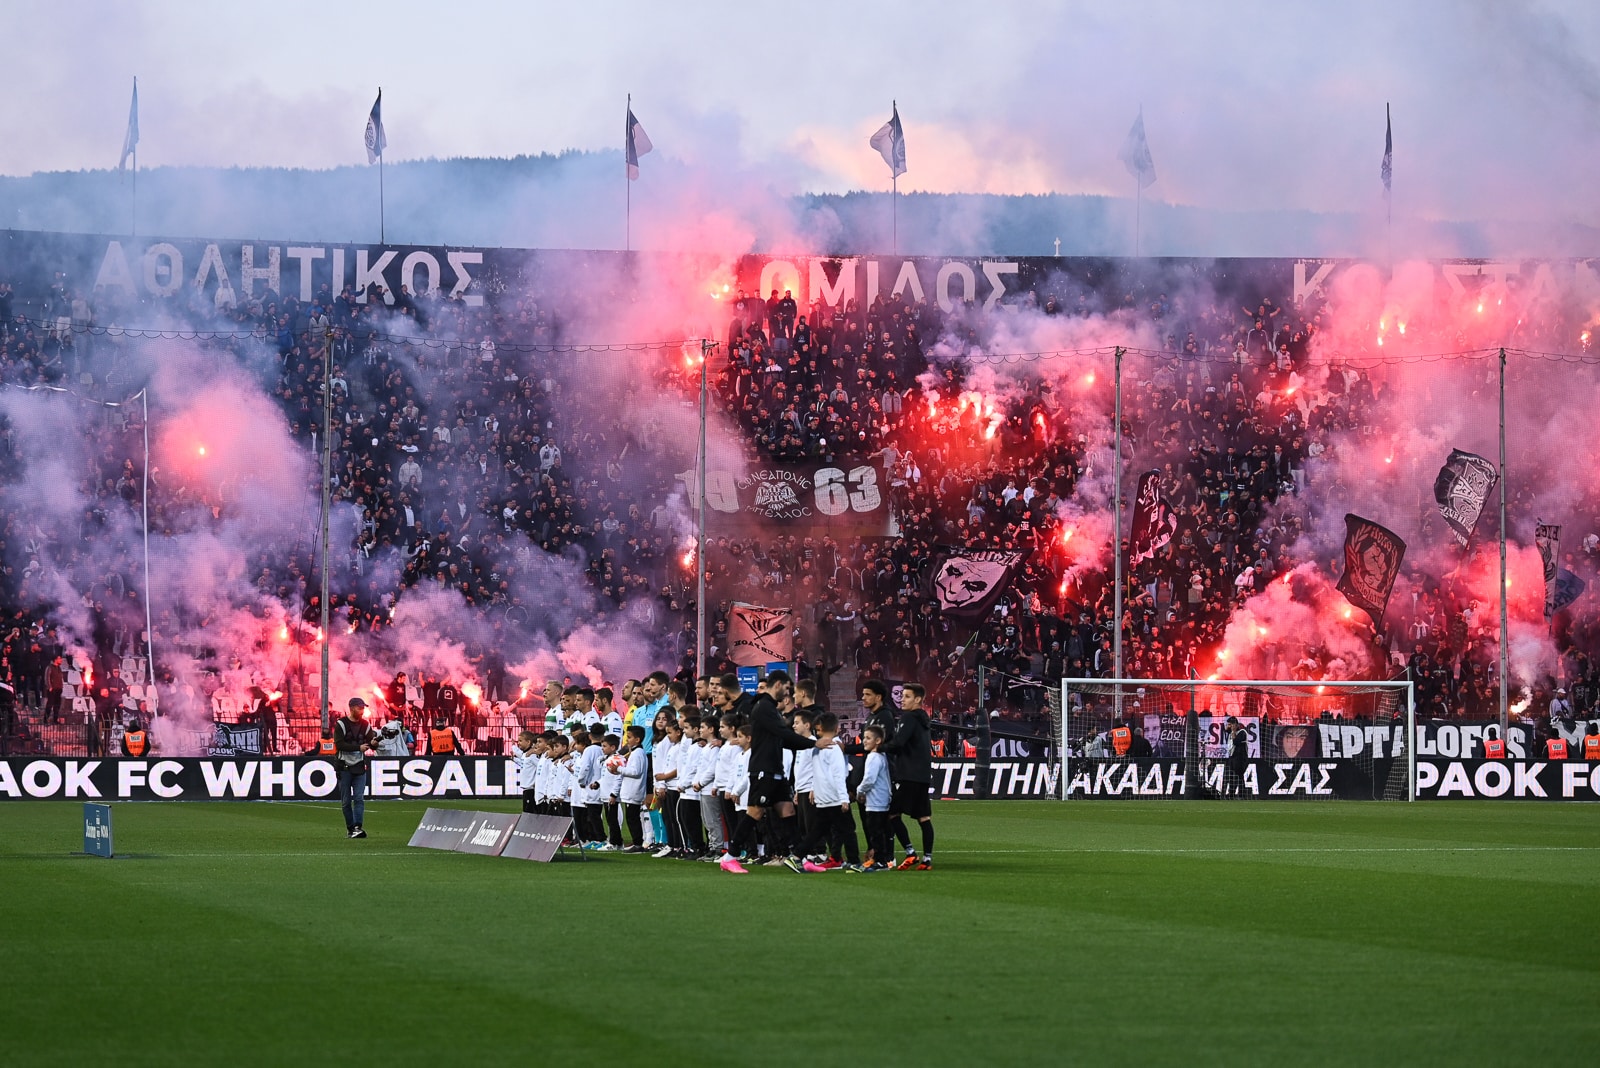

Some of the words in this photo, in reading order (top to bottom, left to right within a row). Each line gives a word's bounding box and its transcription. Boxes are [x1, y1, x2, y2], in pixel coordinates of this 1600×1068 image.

[93, 240, 484, 306] ΑΘΛΗΤΙΚΟΣ
[813, 465, 881, 516] 63
[118, 760, 185, 798] FC
[200, 759, 523, 797] WHOESALE
[988, 762, 1061, 795] ΤΗΝ
[1067, 762, 1260, 795] ΑΚΑΔΗΜΑ
[1268, 763, 1338, 795] ΣΑΣ
[1416, 761, 1549, 797] PAOK
